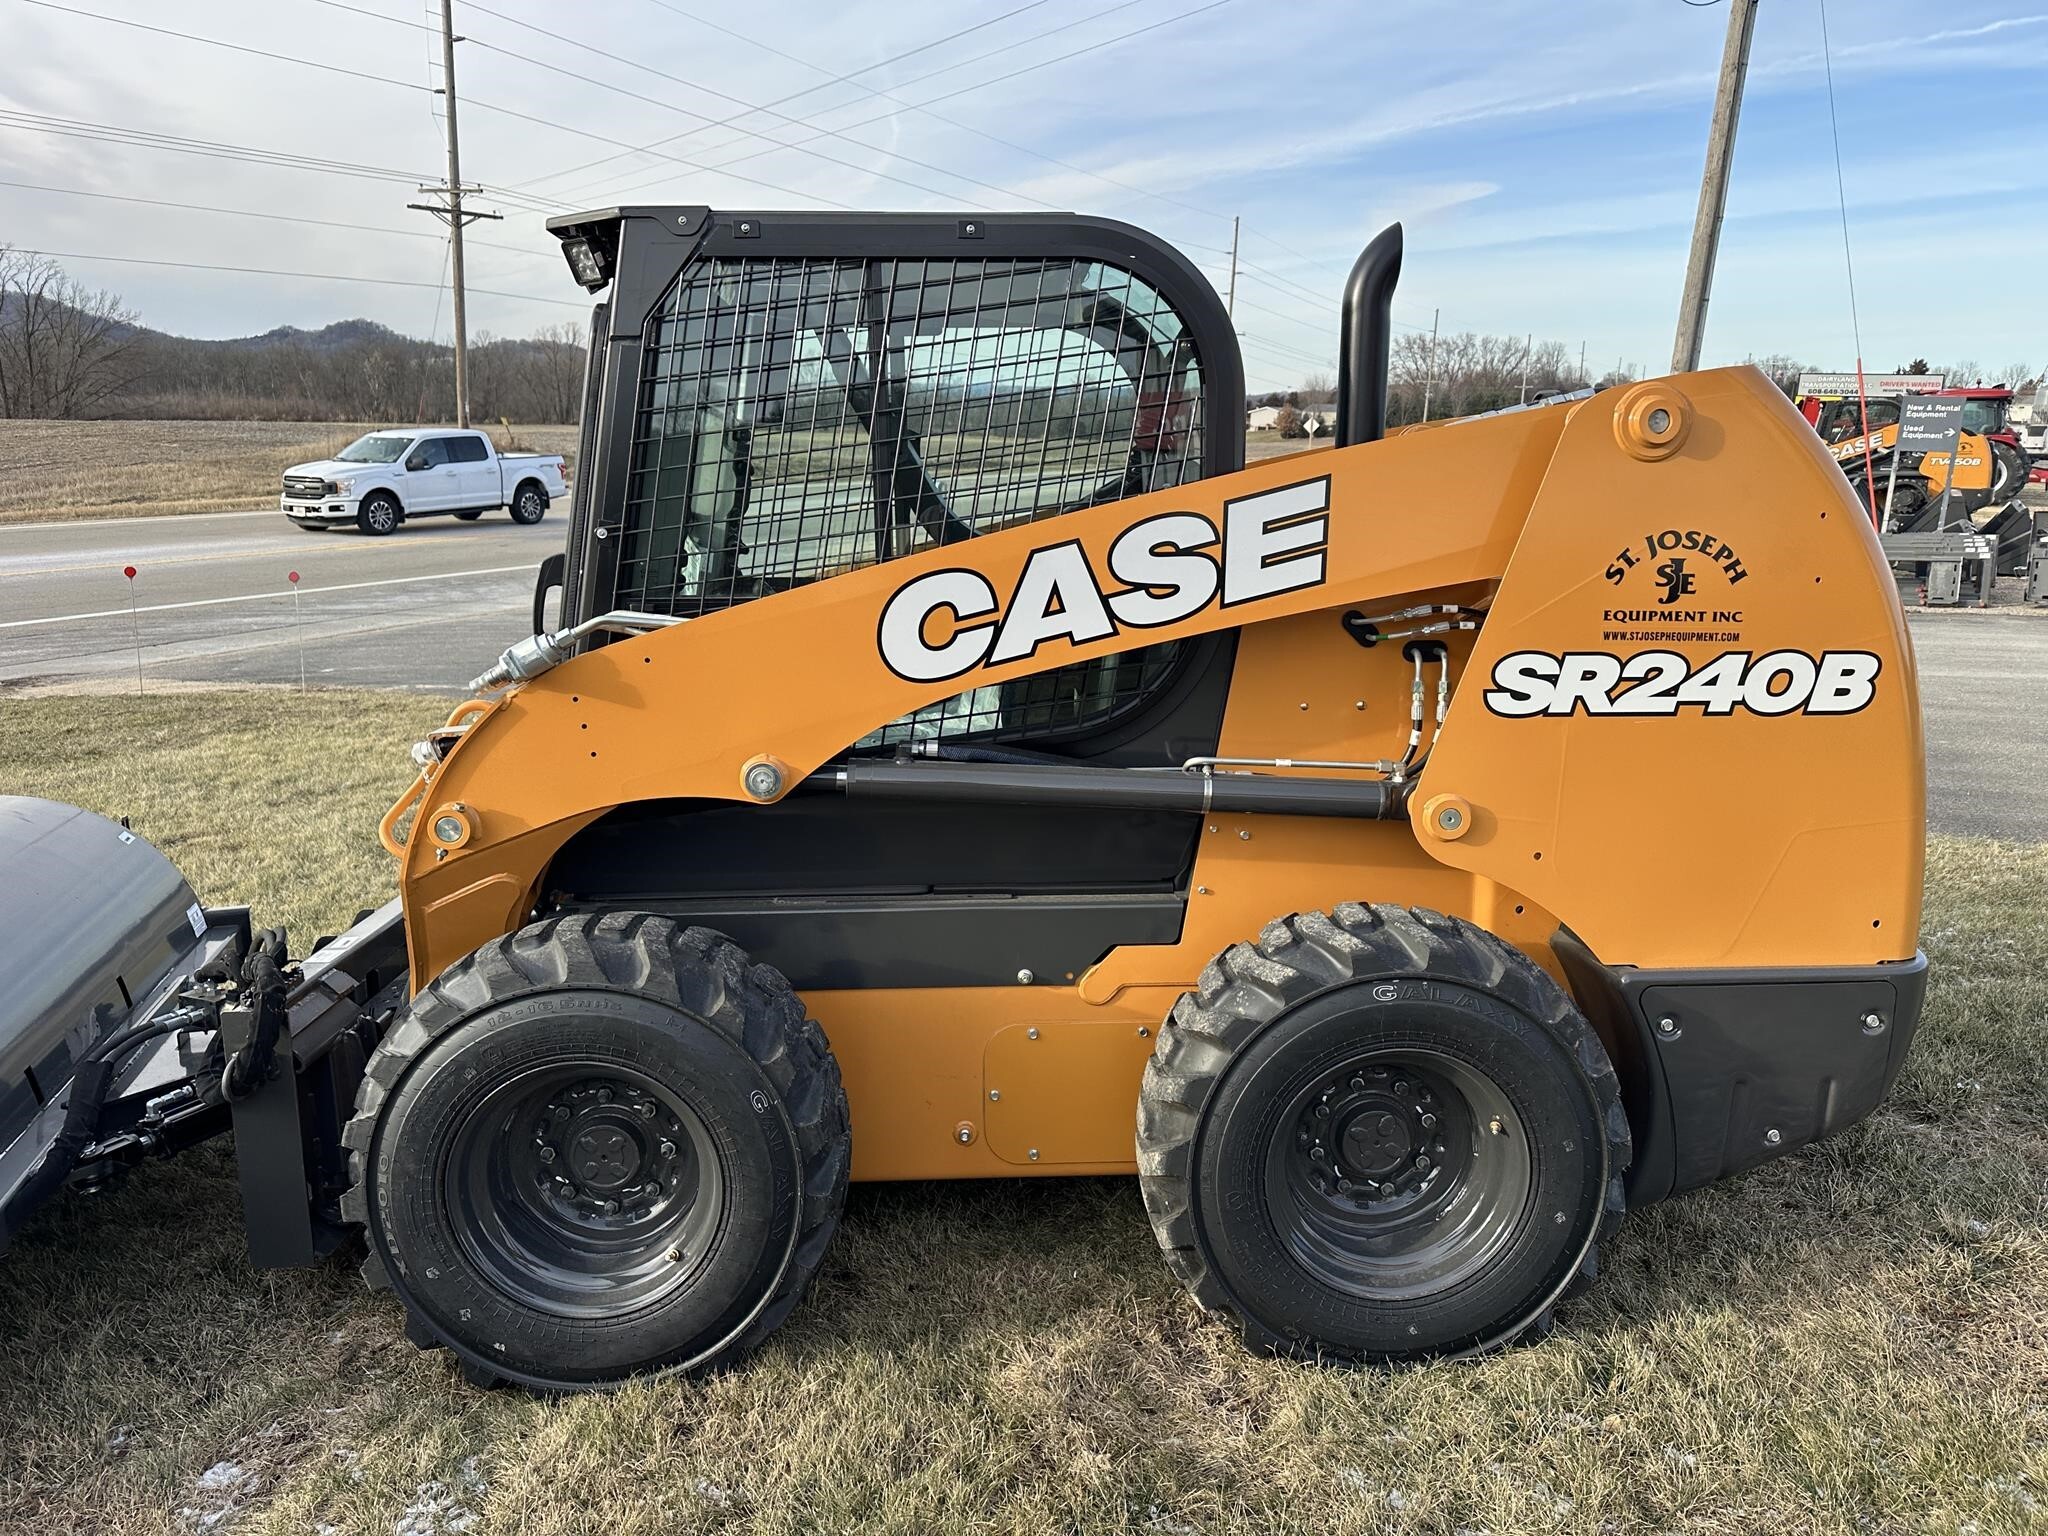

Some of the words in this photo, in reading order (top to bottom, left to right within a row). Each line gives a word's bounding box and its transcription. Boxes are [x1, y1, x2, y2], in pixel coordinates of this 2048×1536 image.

[1935, 404, 1961, 412] Rental
[1829, 431, 1883, 459] CASE
[1604, 548, 1641, 587] ST.
[1644, 529, 1748, 585] JOSEPH
[877, 473, 1332, 684] CASE
[1603, 609, 1707, 623] EQUIPMENT
[1712, 610, 1743, 623] INC
[1602, 631, 1741, 642] WWW.STJOSEPHEQUIPMENT.COM
[1483, 649, 1882, 719] SR240B
[1372, 983, 1533, 1036] GALAXY
